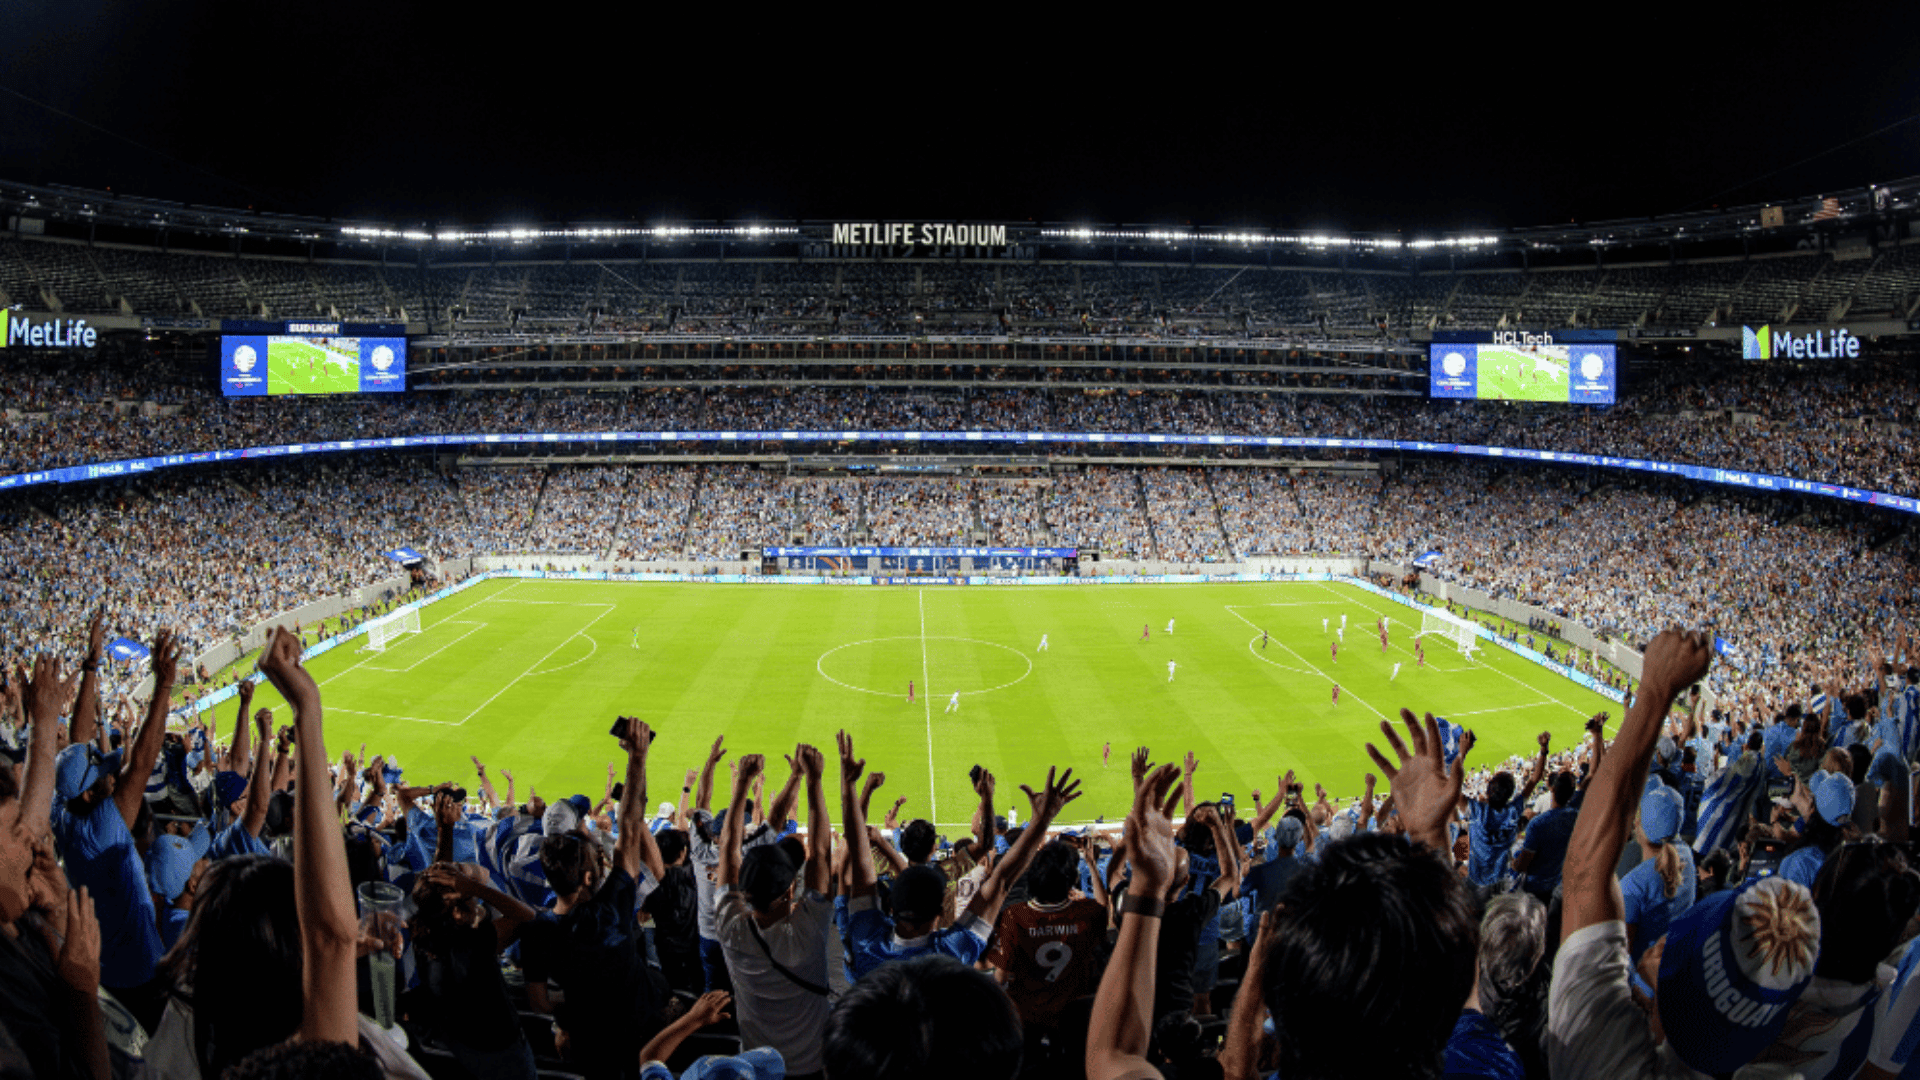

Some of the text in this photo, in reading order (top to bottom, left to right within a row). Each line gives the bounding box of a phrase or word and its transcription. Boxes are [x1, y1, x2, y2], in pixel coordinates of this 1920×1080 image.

[833, 223, 1006, 246] METLIFE STADIUM
[9, 318, 97, 348] MetLife
[1493, 331, 1553, 346] HCLTech
[1773, 328, 1860, 360] MetLife
[1029, 924, 1079, 938] DARWIN
[1035, 941, 1073, 983] 9
[1702, 930, 1787, 1028] URUGUAY
